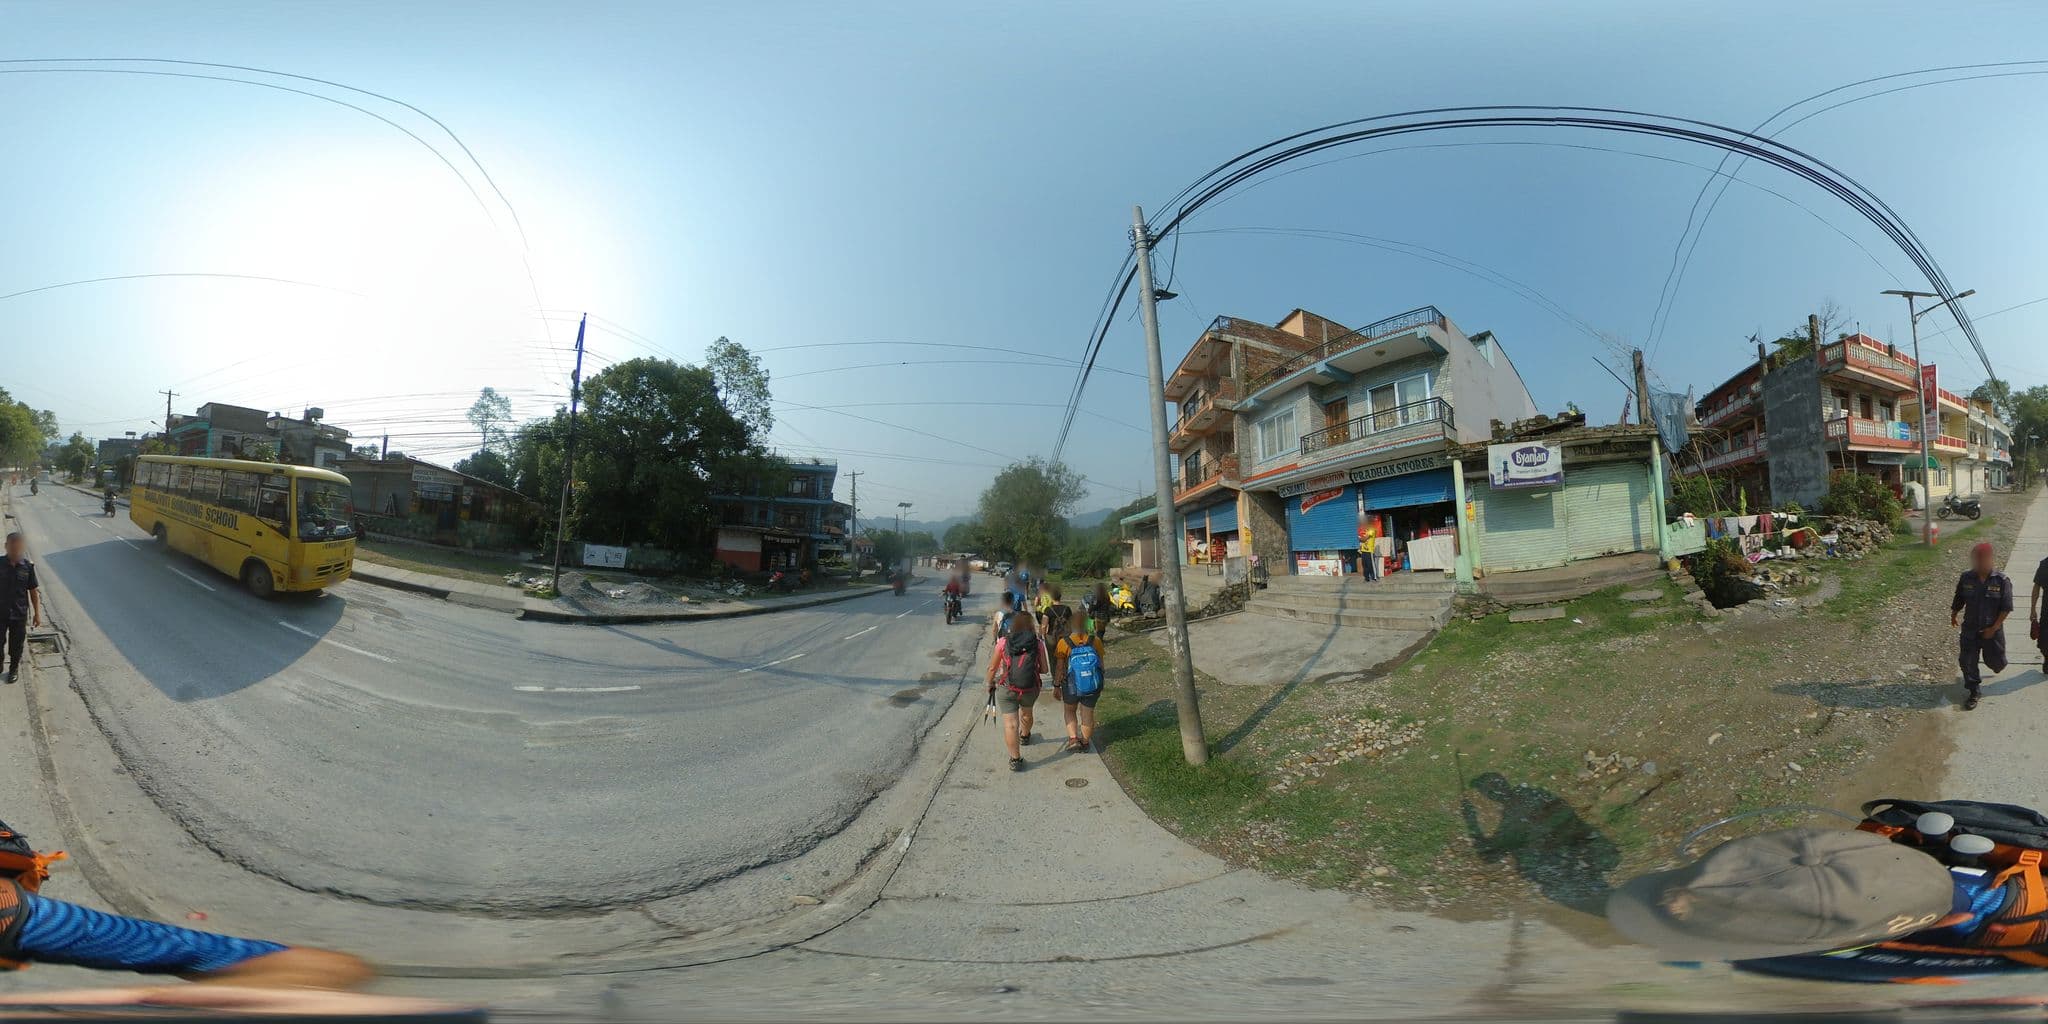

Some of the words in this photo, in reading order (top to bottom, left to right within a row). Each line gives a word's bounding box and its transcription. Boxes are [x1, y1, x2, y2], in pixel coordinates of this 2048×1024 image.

[1515, 447, 1547, 467] Byanjan
[1353, 464, 1396, 482] PRADHAN
[205, 507, 240, 531] SCHOOL
